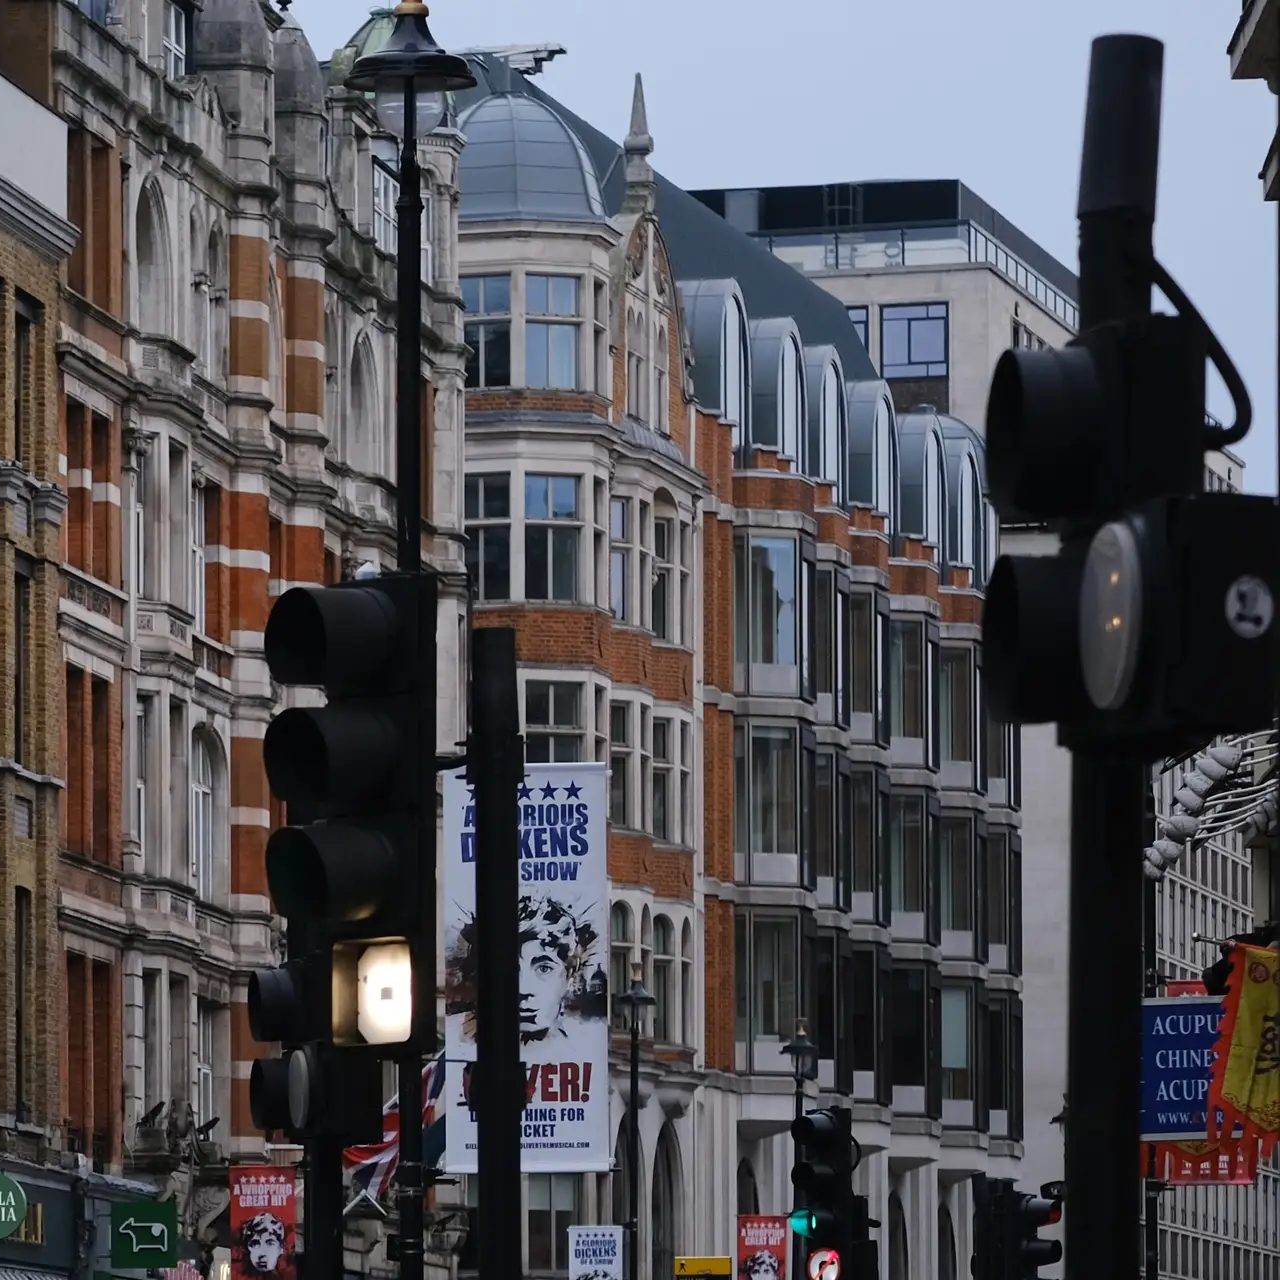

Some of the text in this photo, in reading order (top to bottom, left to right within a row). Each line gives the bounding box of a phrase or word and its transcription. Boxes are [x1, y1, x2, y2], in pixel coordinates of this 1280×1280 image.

[461, 825, 588, 863] DKENS
[1152, 1014, 1219, 1036] ACUPU
[1155, 1048, 1216, 1069] CHINE
[1155, 1079, 1210, 1101] ACUP
[561, 1108, 585, 1122] FOR
[239, 1194, 287, 1207] GREAT HIT
[574, 1247, 617, 1258] DICKENS
